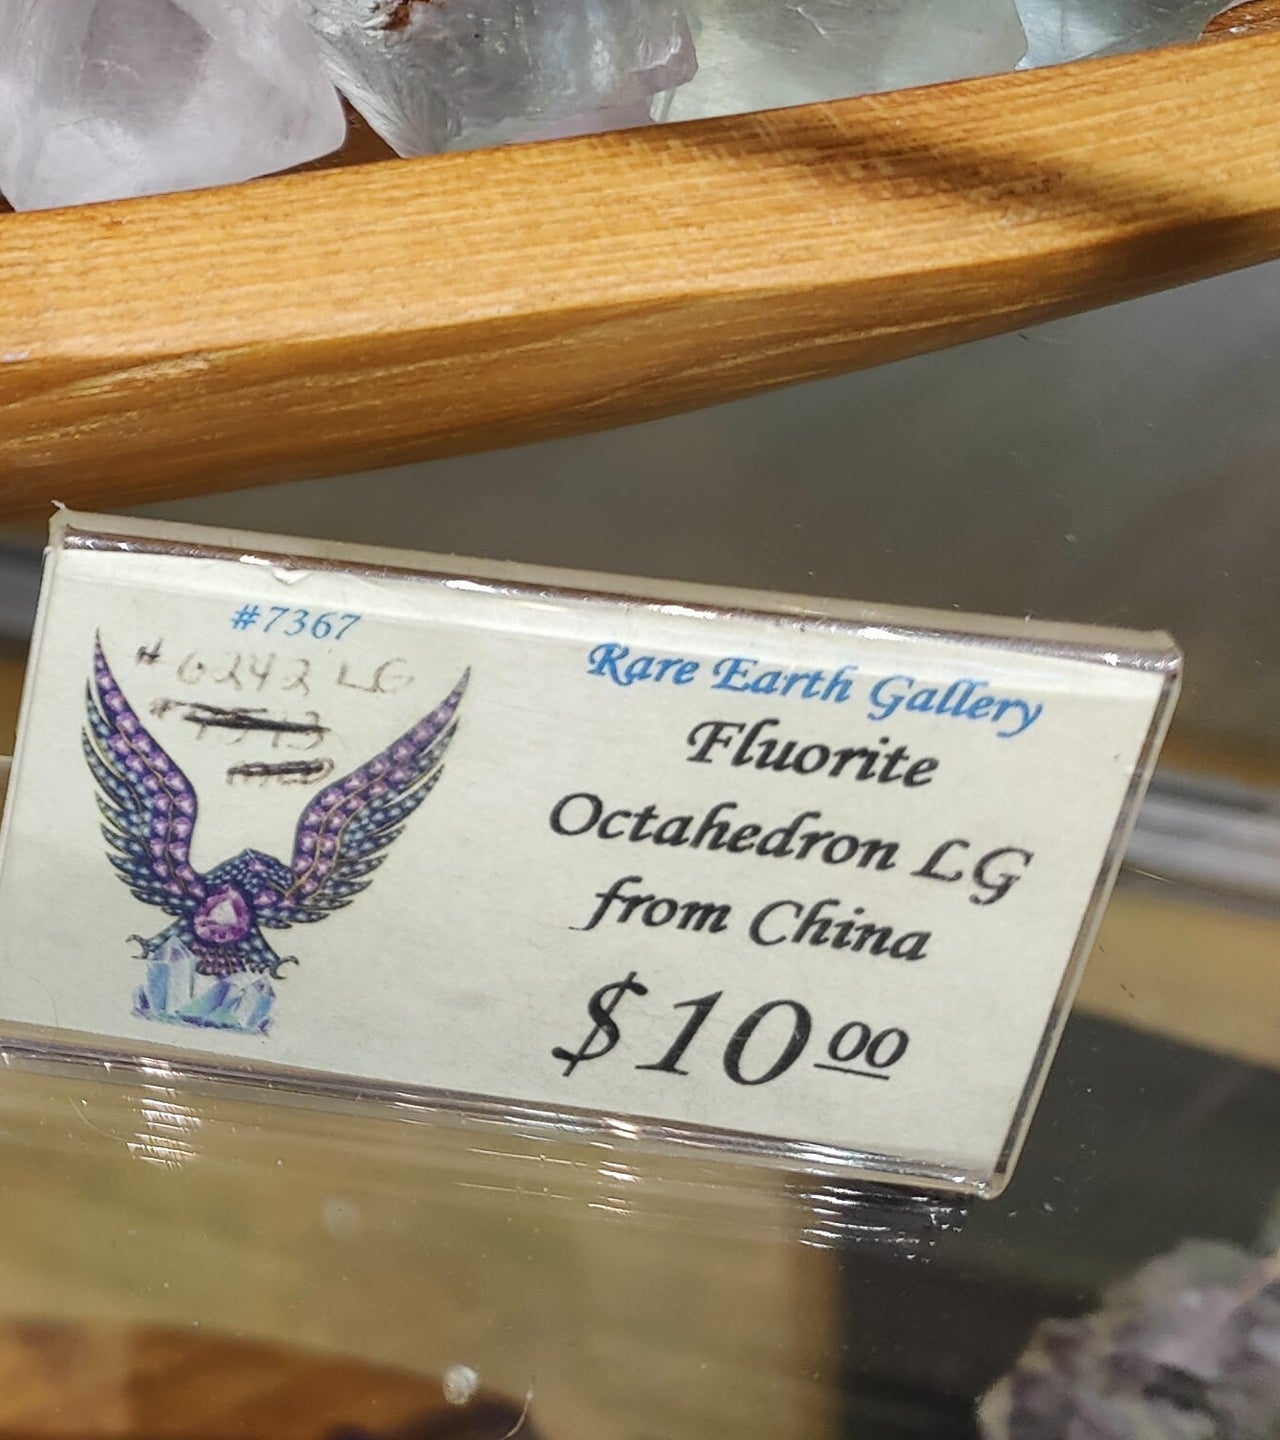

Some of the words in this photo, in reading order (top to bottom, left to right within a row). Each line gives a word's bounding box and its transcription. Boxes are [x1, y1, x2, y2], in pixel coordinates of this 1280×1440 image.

[230, 604, 362, 641] #7367
[587, 641, 699, 687] Rare
[711, 655, 859, 704] Earth
[867, 674, 1044, 739] Gallery
[686, 718, 940, 788] Fluorite
[548, 791, 901, 872] Octahedron
[912, 837, 1036, 906] LG
[568, 875, 733, 932] from
[748, 897, 933, 963] China
